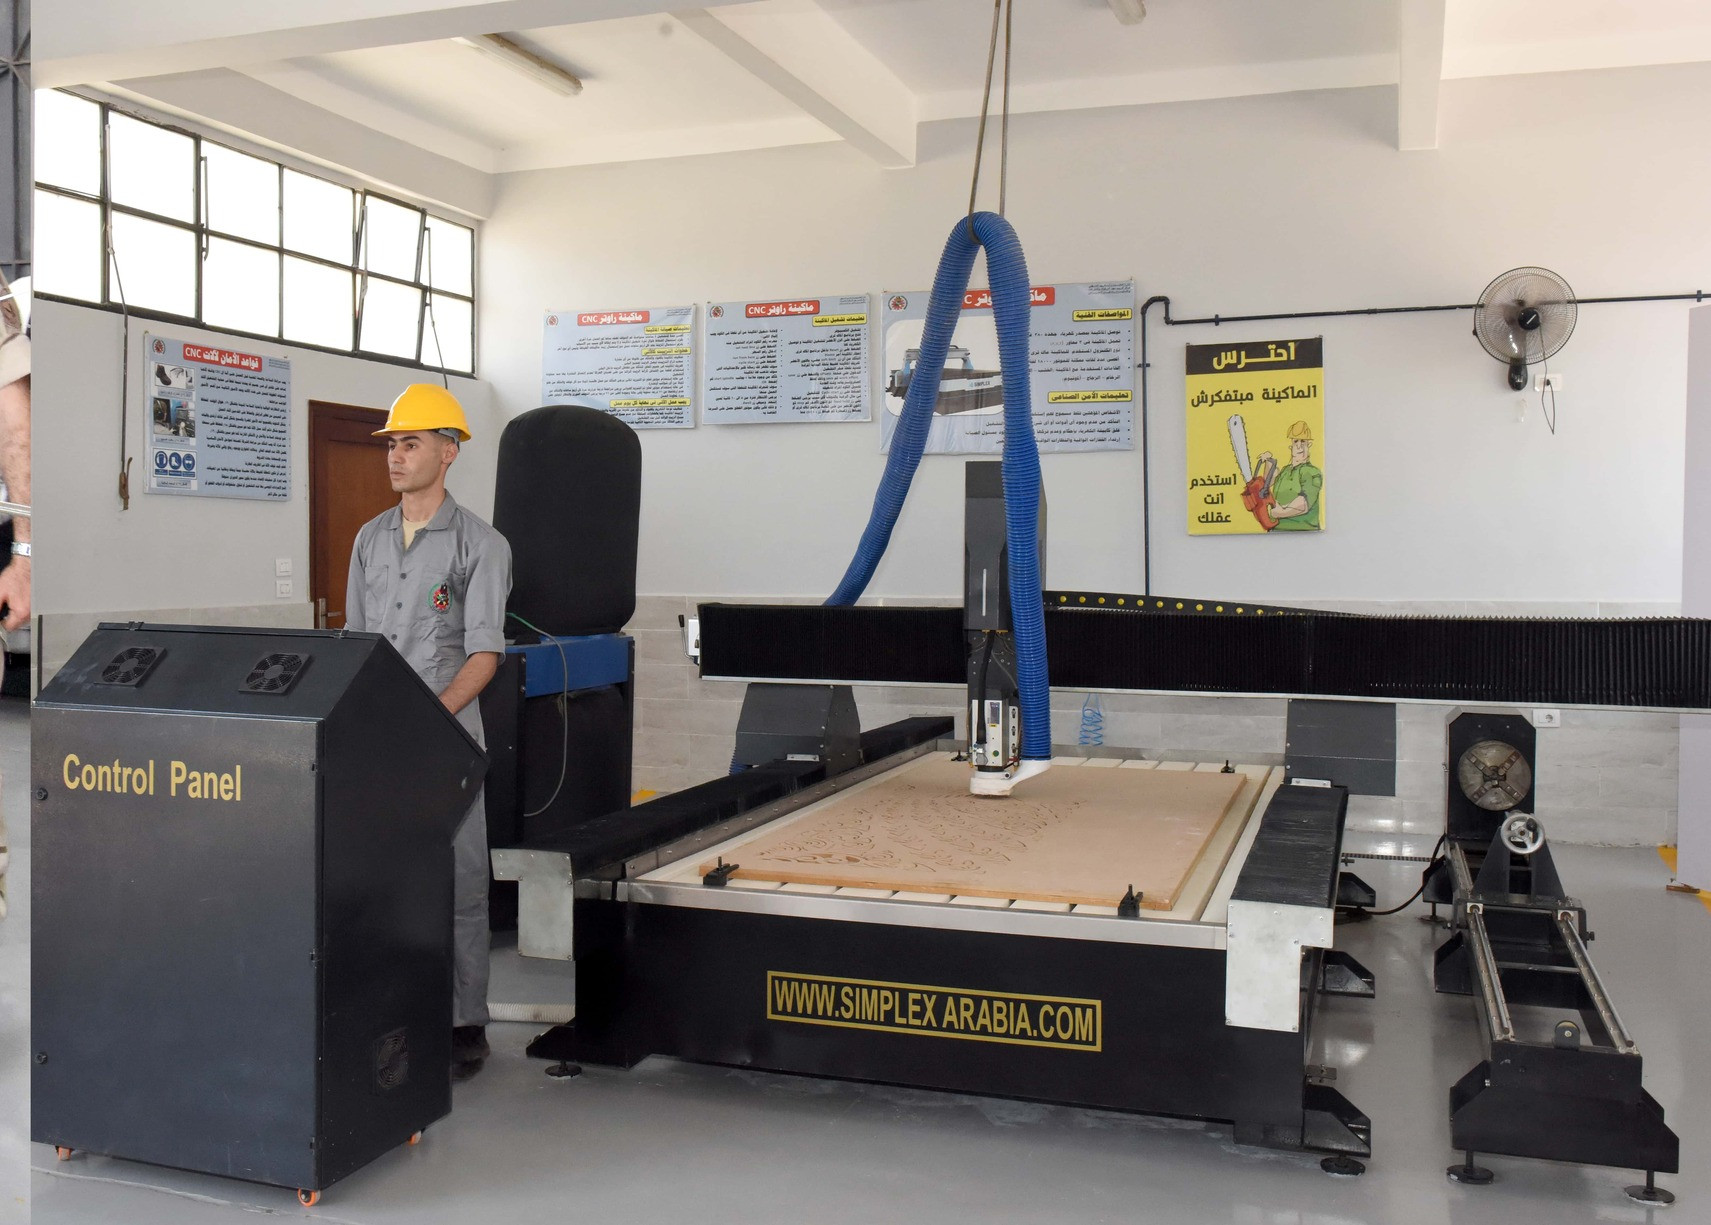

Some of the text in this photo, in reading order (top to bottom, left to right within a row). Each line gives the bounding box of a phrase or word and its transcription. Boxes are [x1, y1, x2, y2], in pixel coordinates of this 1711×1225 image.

[748, 302, 814, 316] ماكينة راوتر CNC
[581, 312, 643, 324] ماكينة راوتر CNC
[185, 347, 202, 358] CNC
[1212, 341, 1295, 370] احترس
[241, 357, 259, 369] قواعد
[1191, 385, 1317, 408] الماكينة مبتفكرش
[1189, 473, 1237, 490] استخدم
[1204, 492, 1224, 505] انت
[1197, 512, 1231, 524] عقلك
[63, 753, 242, 801] Control Panel
